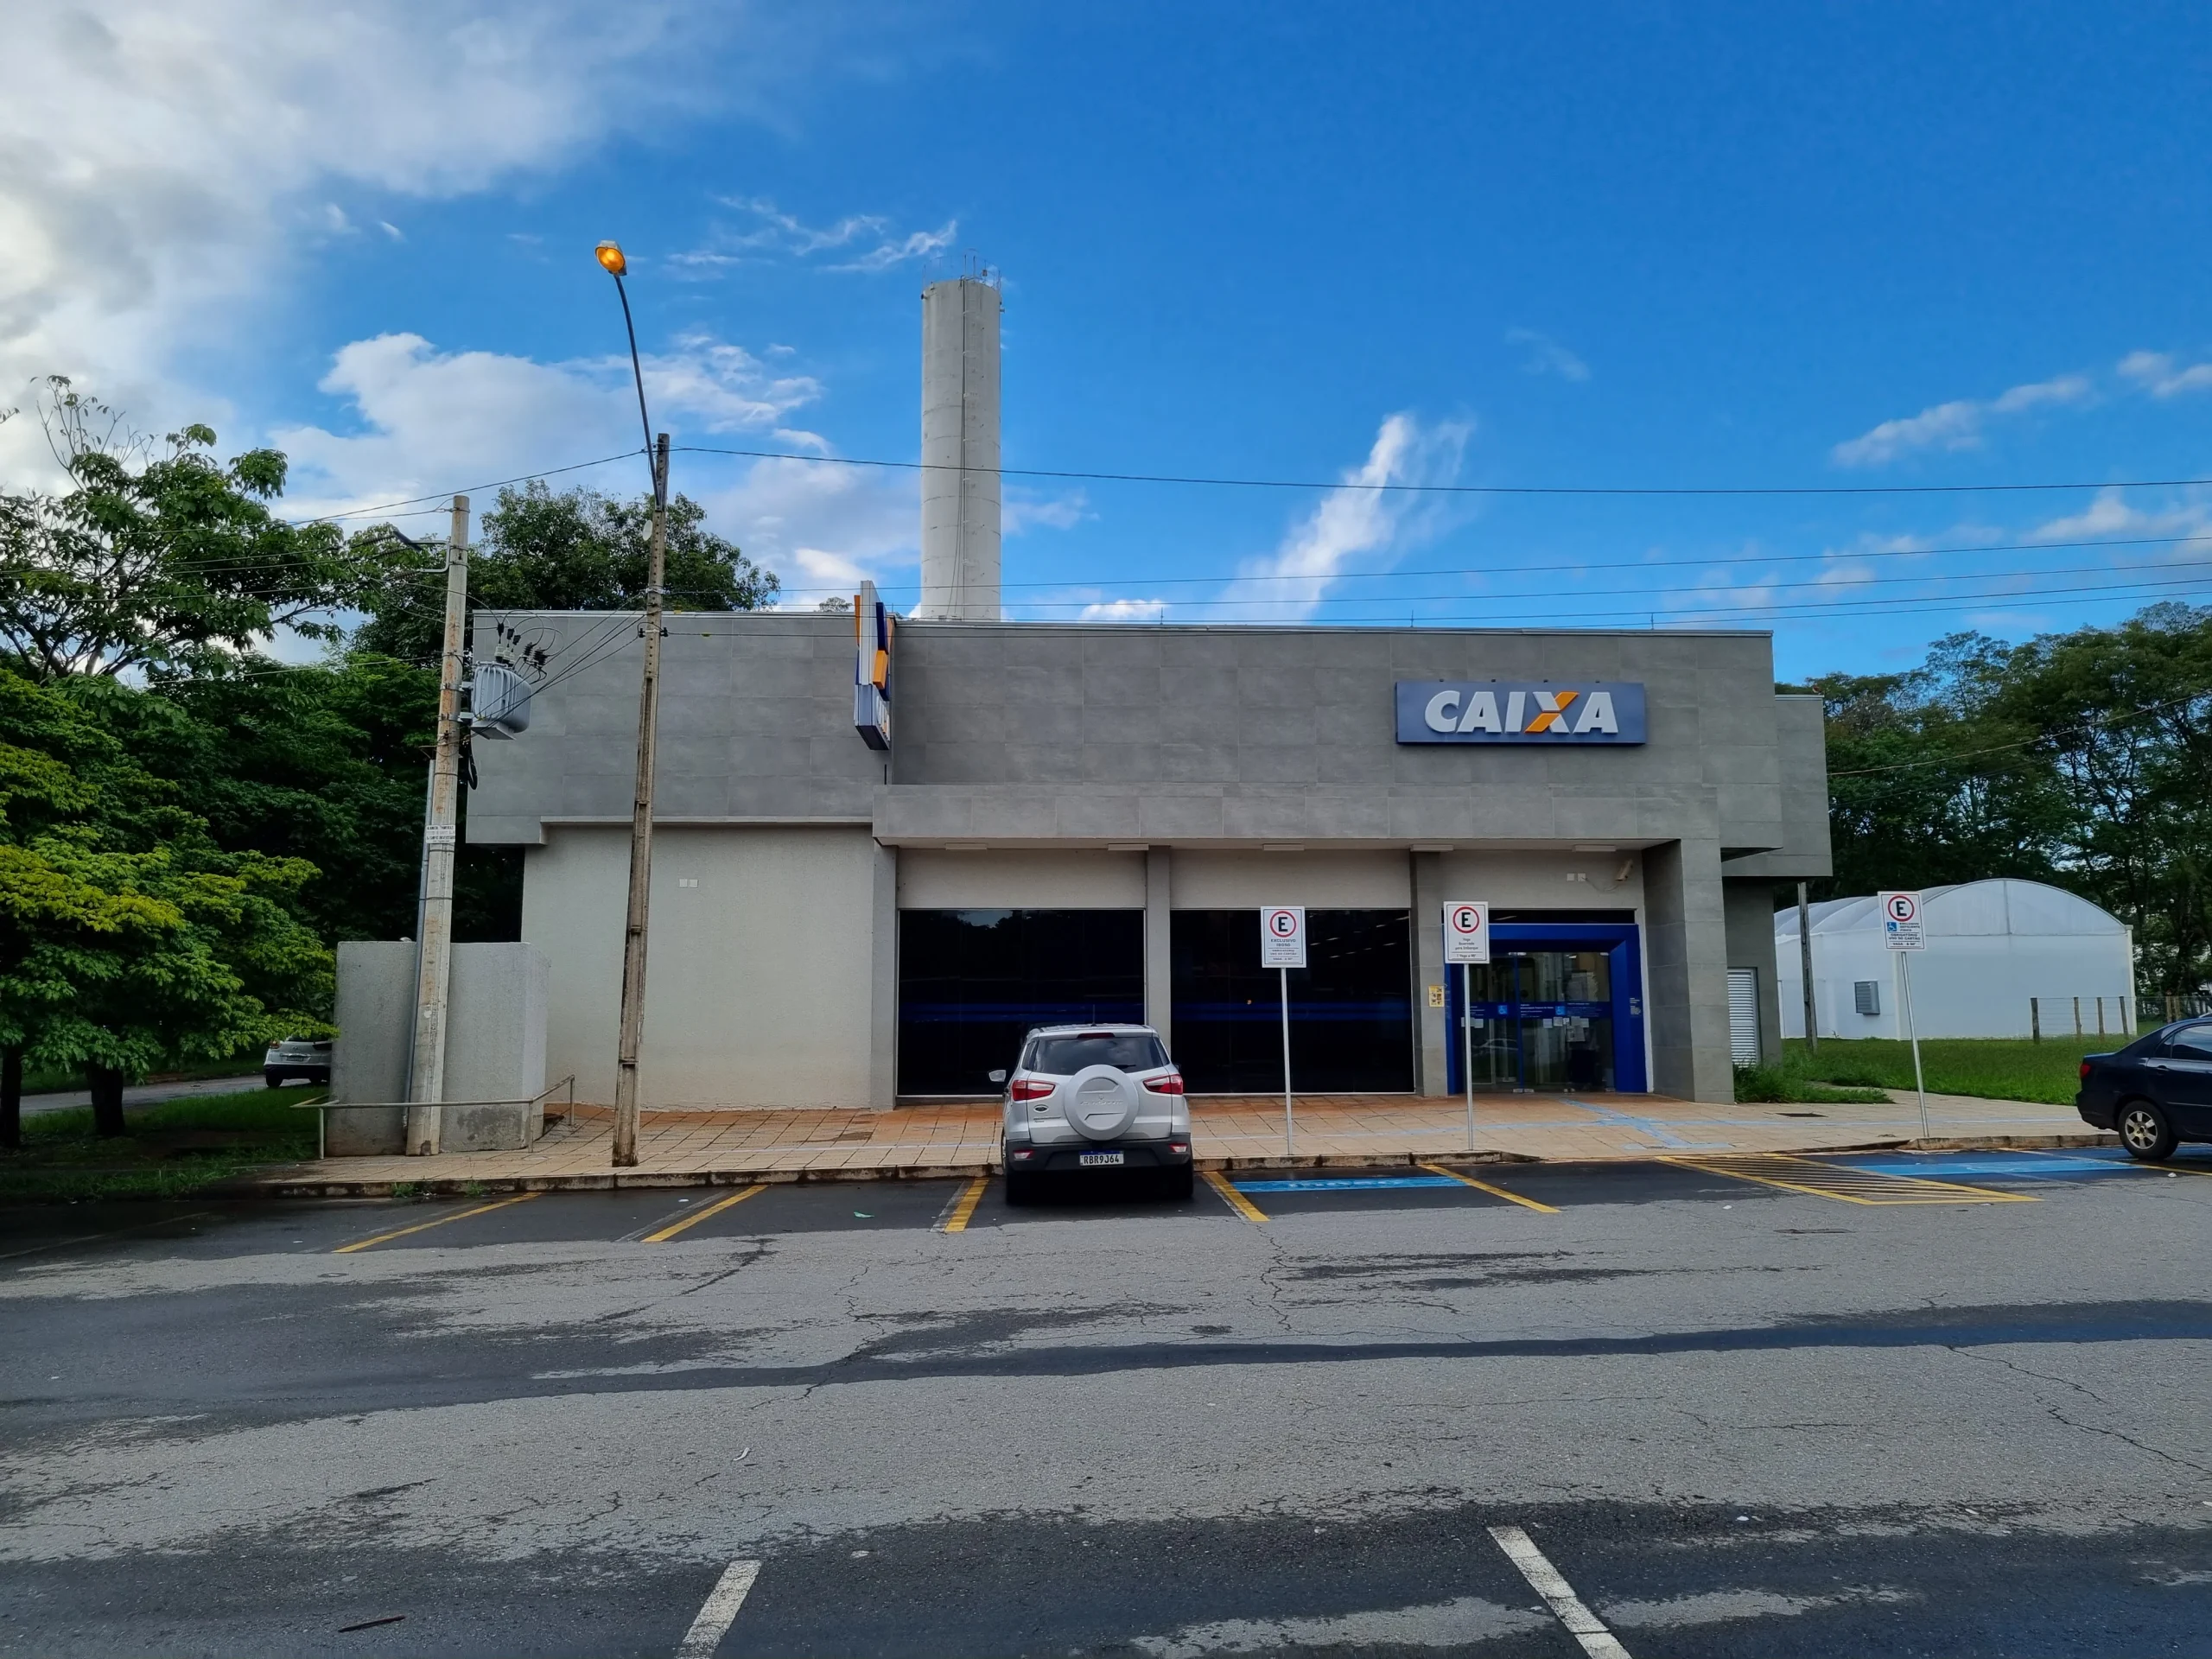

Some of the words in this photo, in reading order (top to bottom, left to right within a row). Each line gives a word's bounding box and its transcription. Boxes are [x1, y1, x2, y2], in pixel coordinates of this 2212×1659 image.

[1424, 690, 1619, 734] CAIXA
[1896, 900, 1907, 917] E
[1278, 916, 1288, 932] E
[1461, 912, 1471, 928] E
[1084, 1154, 1120, 1165] RBR9J64
